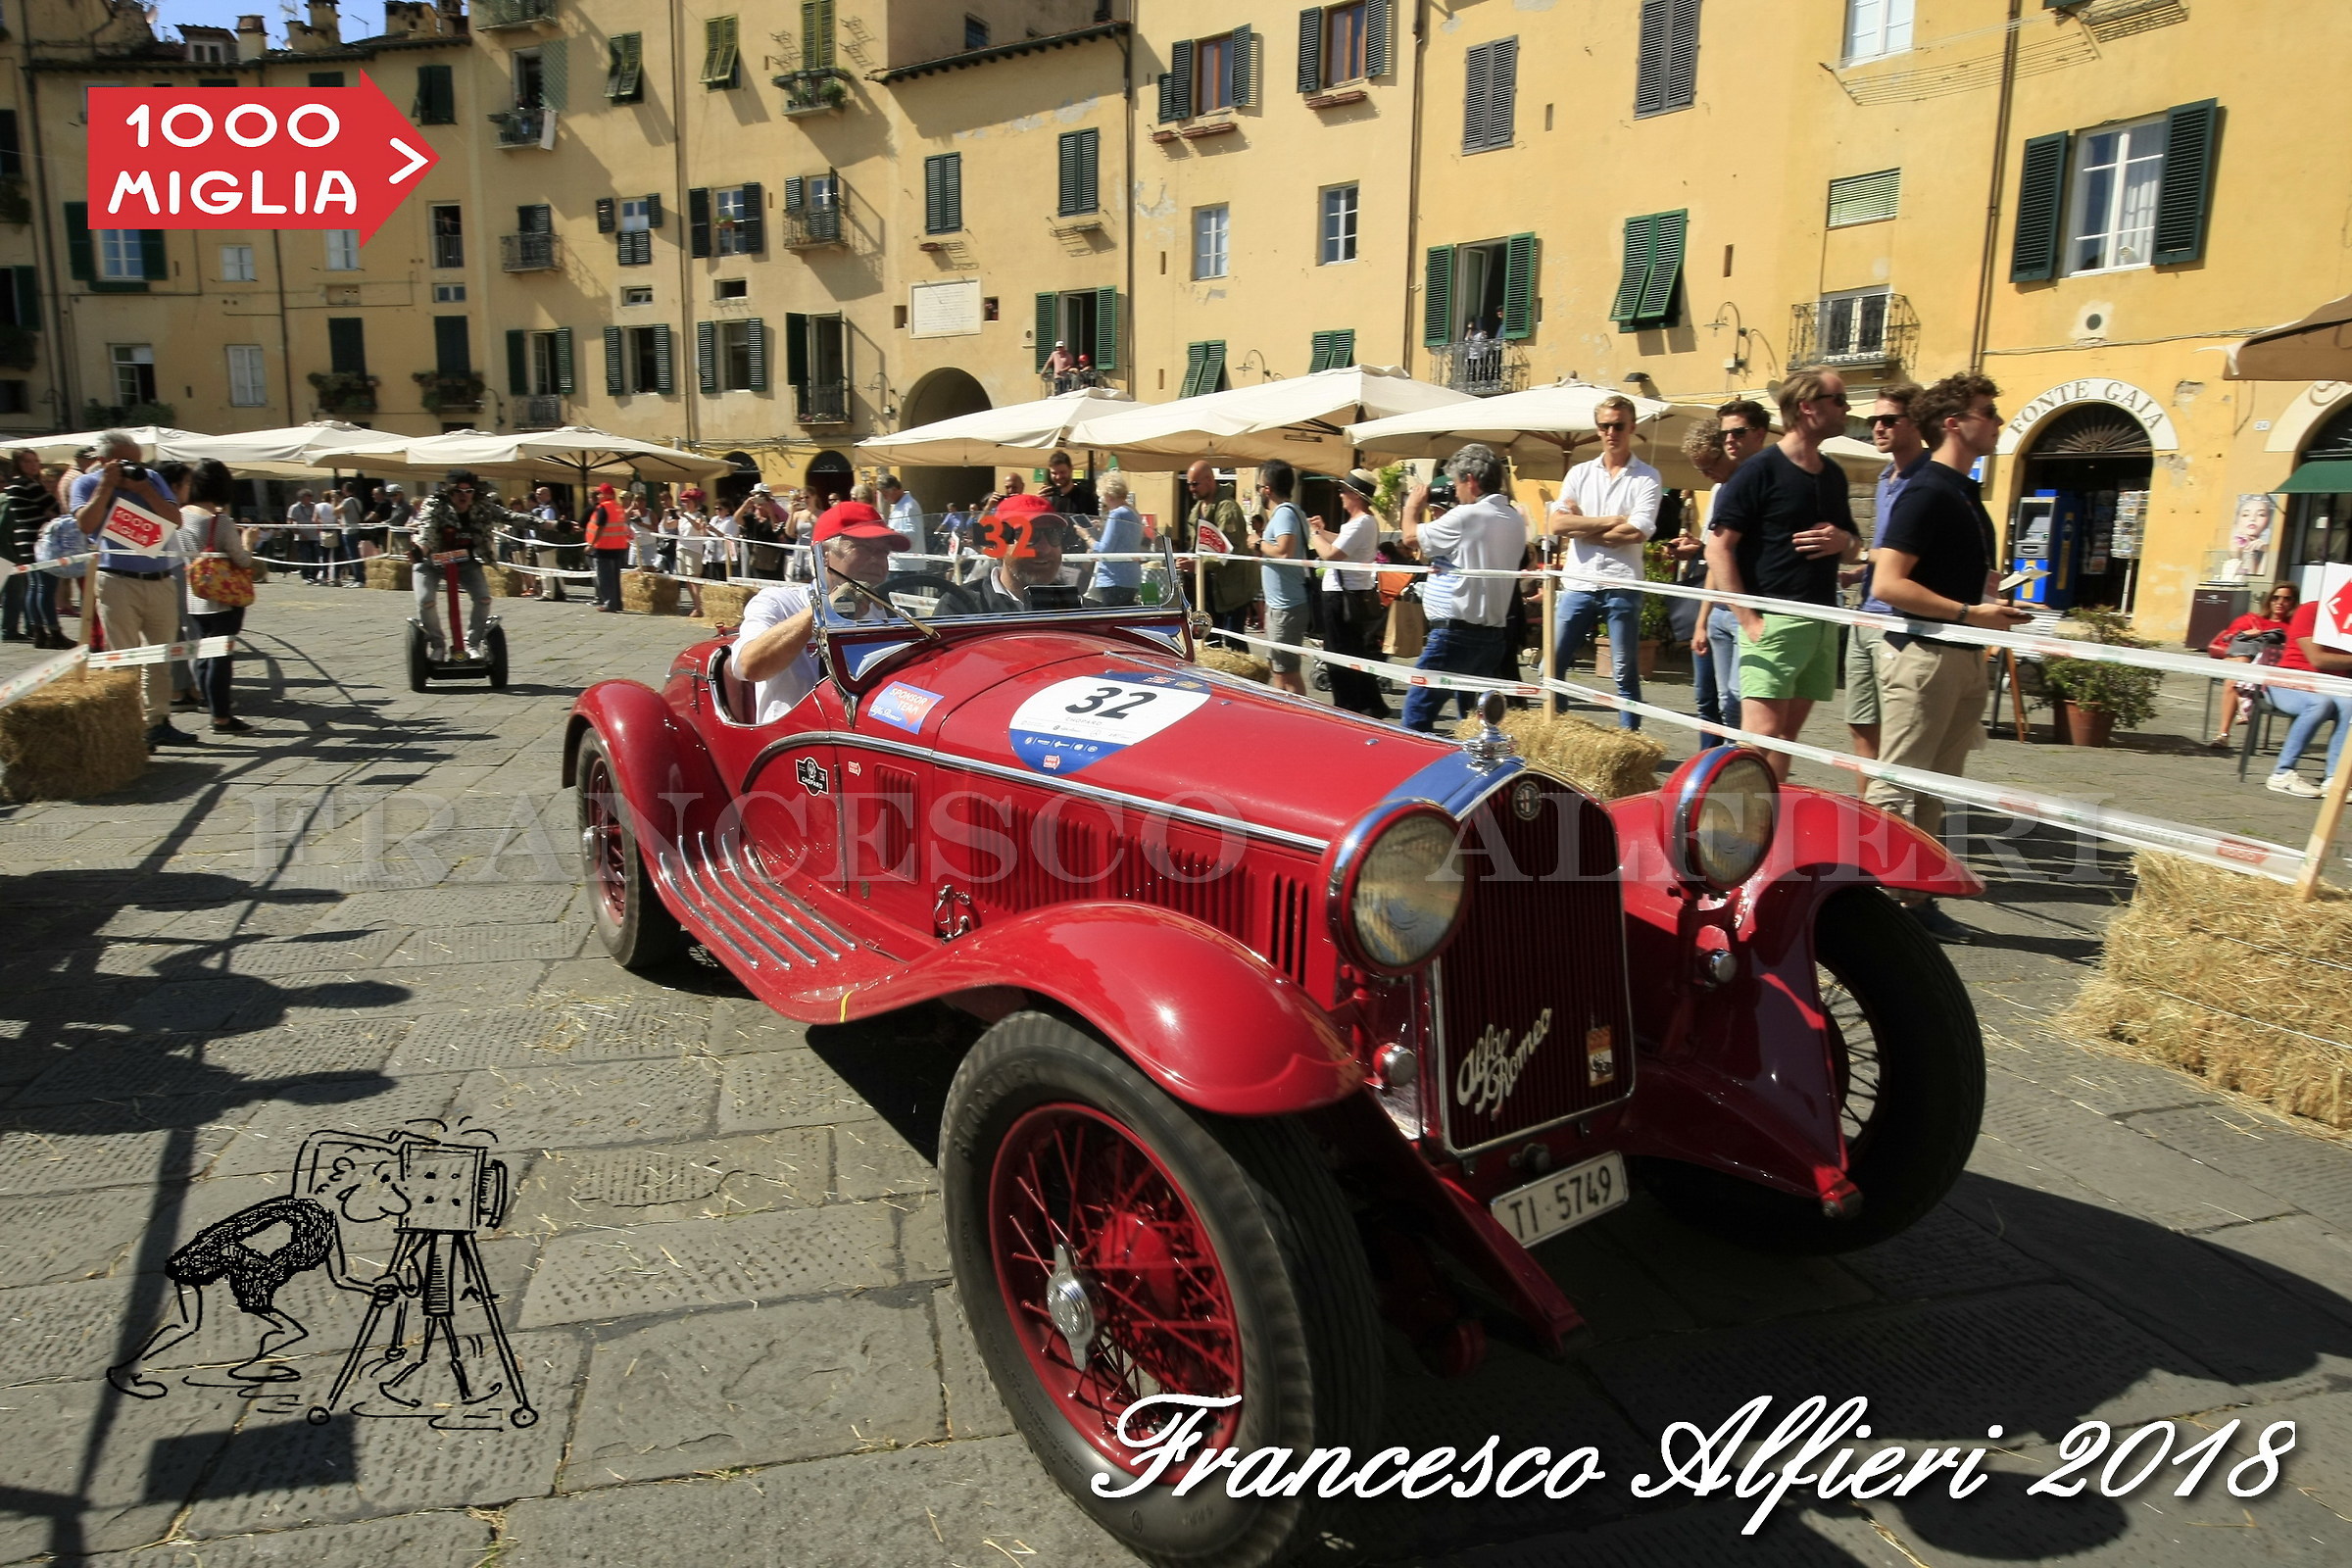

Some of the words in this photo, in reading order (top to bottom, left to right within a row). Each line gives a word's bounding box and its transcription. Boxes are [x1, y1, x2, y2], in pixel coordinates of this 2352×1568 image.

[2010, 380, 2090, 435] FONTE
[2104, 380, 2165, 430] GAIA
[116, 510, 154, 532] 1000
[980, 514, 1036, 560] 32
[889, 687, 928, 706] SPONSOR
[897, 700, 920, 715] TEAM
[1064, 686, 1158, 720] 32
[1065, 716, 1103, 726] CHOPARD
[801, 776, 824, 790] CHOPARD
[1456, 1023, 1511, 1115] Alfa
[1486, 1007, 1553, 1121] Romeo
[1508, 1196, 1540, 1240] TI
[1554, 1164, 1612, 1221] 5749
